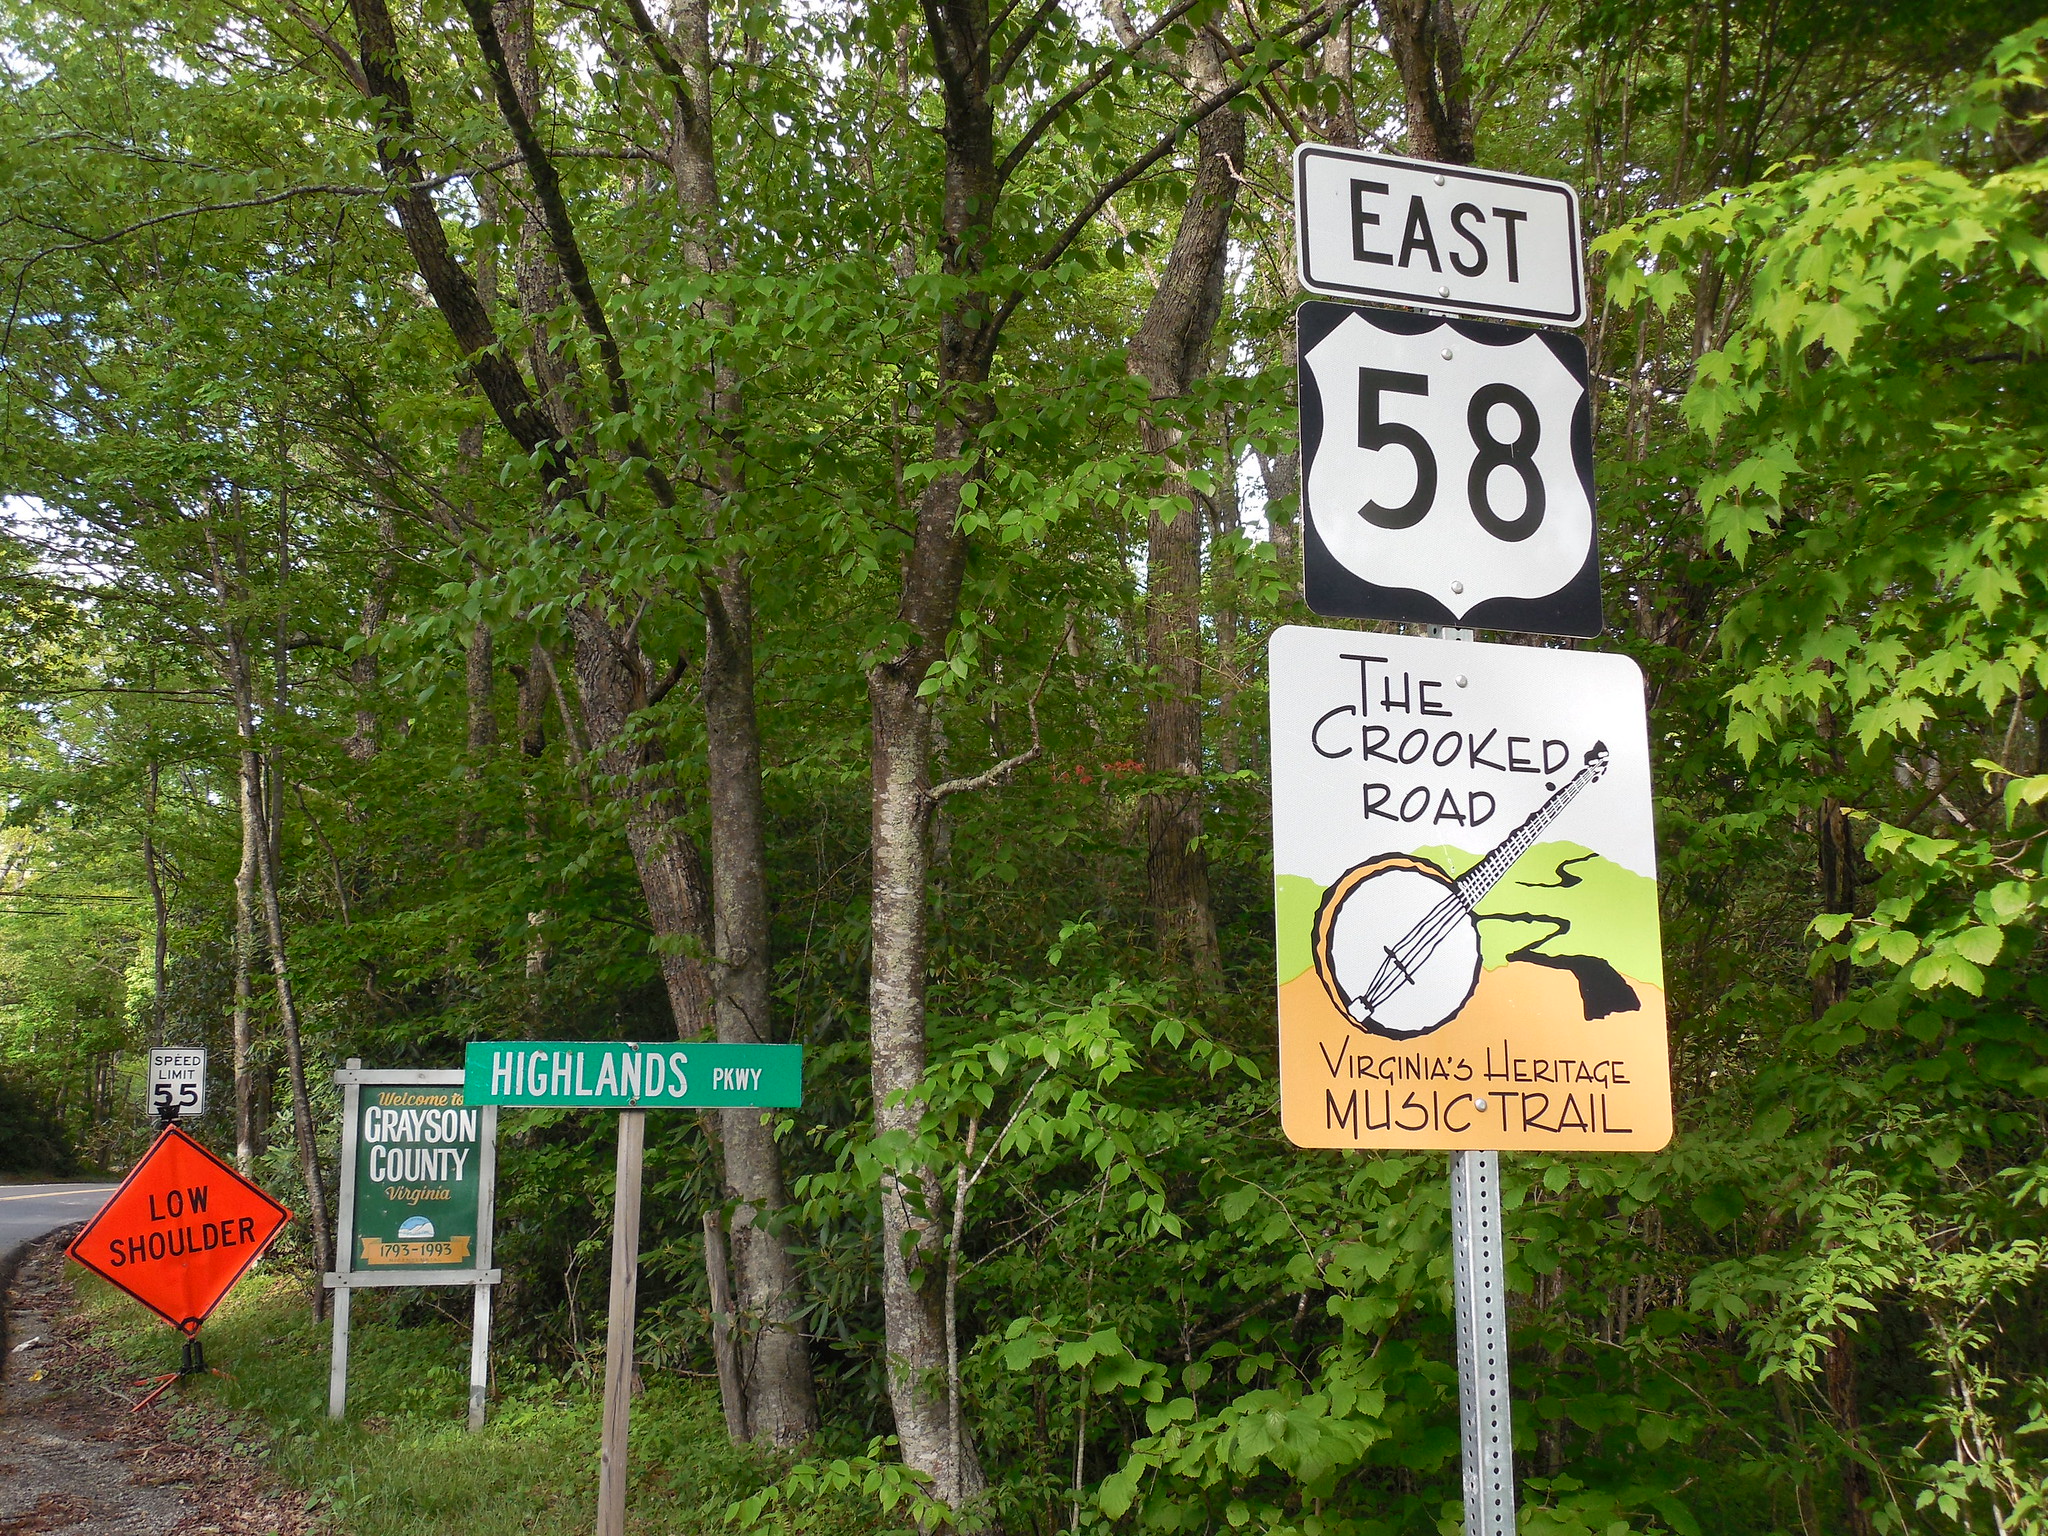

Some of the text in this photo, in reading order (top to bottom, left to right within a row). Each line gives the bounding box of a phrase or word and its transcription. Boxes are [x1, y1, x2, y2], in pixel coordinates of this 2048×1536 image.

[1350, 178, 1527, 282] EAST
[1357, 367, 1546, 543] 58
[1340, 653, 1452, 717] THE
[1312, 705, 1569, 775] CROOKED
[1363, 783, 1495, 827] ROAD
[155, 1055, 201, 1066] SPEED
[159, 1069, 195, 1080] LIMIT
[491, 1050, 762, 1098] HIGHLANDS PKWY
[1319, 1035, 1631, 1085] VIRGINIA'S HERITAGE
[154, 1083, 198, 1107] 55
[378, 1092, 446, 1106] Welcome
[1326, 1089, 1633, 1140] MUSIC TRAIL
[364, 1106, 477, 1143] GRAYSON
[370, 1145, 470, 1182] COUNTY
[149, 1186, 209, 1222] LOW
[384, 1185, 451, 1206] Virginia
[109, 1217, 256, 1267] SHOULDER
